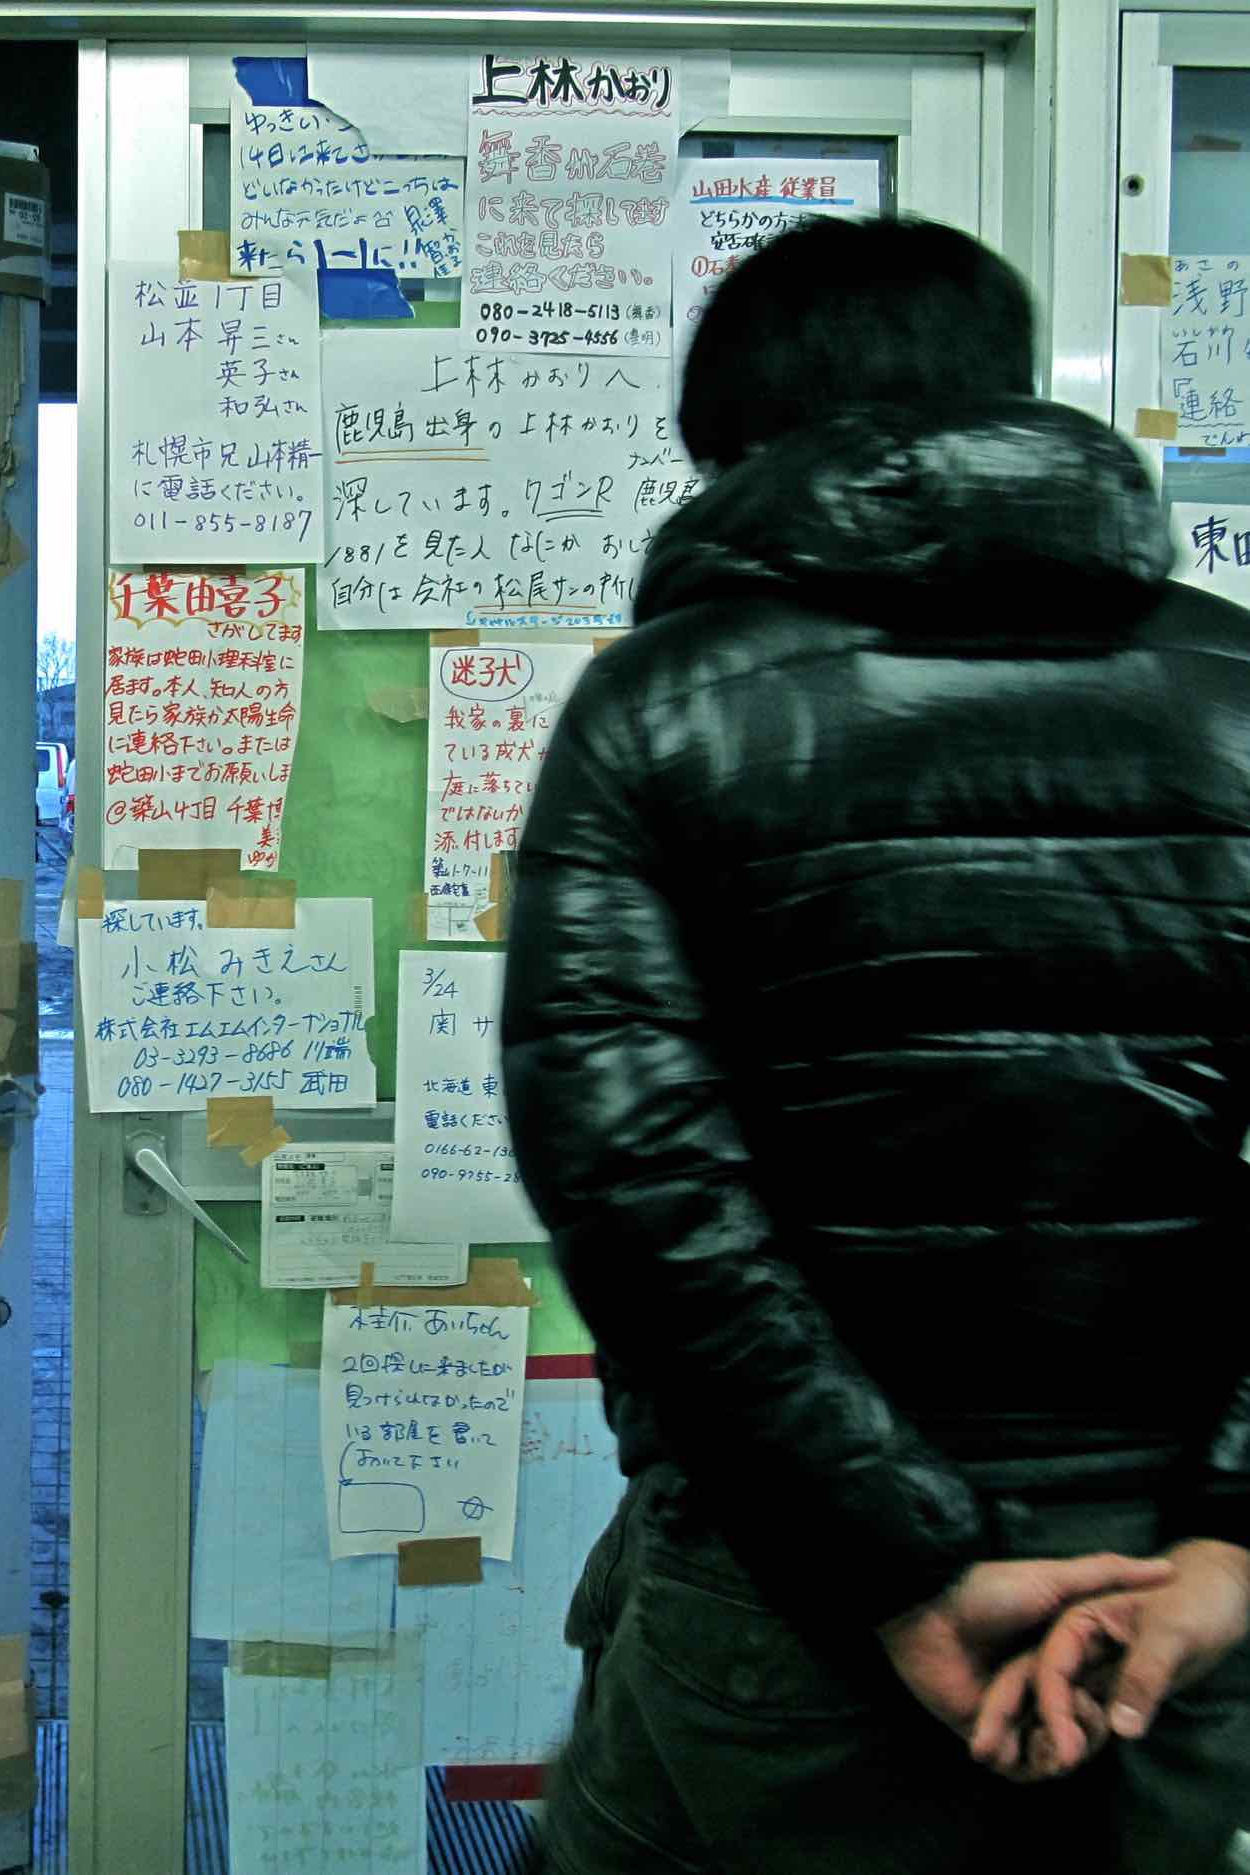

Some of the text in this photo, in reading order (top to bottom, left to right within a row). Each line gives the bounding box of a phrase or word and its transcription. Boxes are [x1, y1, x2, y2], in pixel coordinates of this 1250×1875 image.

[472, 53, 671, 108] 上林かおり
[475, 231, 607, 260] これを見たら
[711, 231, 775, 251] 安否確
[480, 301, 620, 321] 080-2418-5113
[476, 327, 618, 347] 090-3725-4556
[216, 358, 300, 388] 英子さん
[421, 354, 641, 397] 上林かおりへ
[134, 474, 304, 502] に電話ください。
[134, 510, 312, 543] 011-855-8187
[207, 620, 302, 642] さがしてます
[452, 653, 523, 688] 迷子犬
[102, 906, 204, 932] 探しています。
[122, 943, 349, 979] 小松みきえさん
[421, 967, 459, 999] 3/24
[134, 1040, 295, 1070] 03-3293-8686
